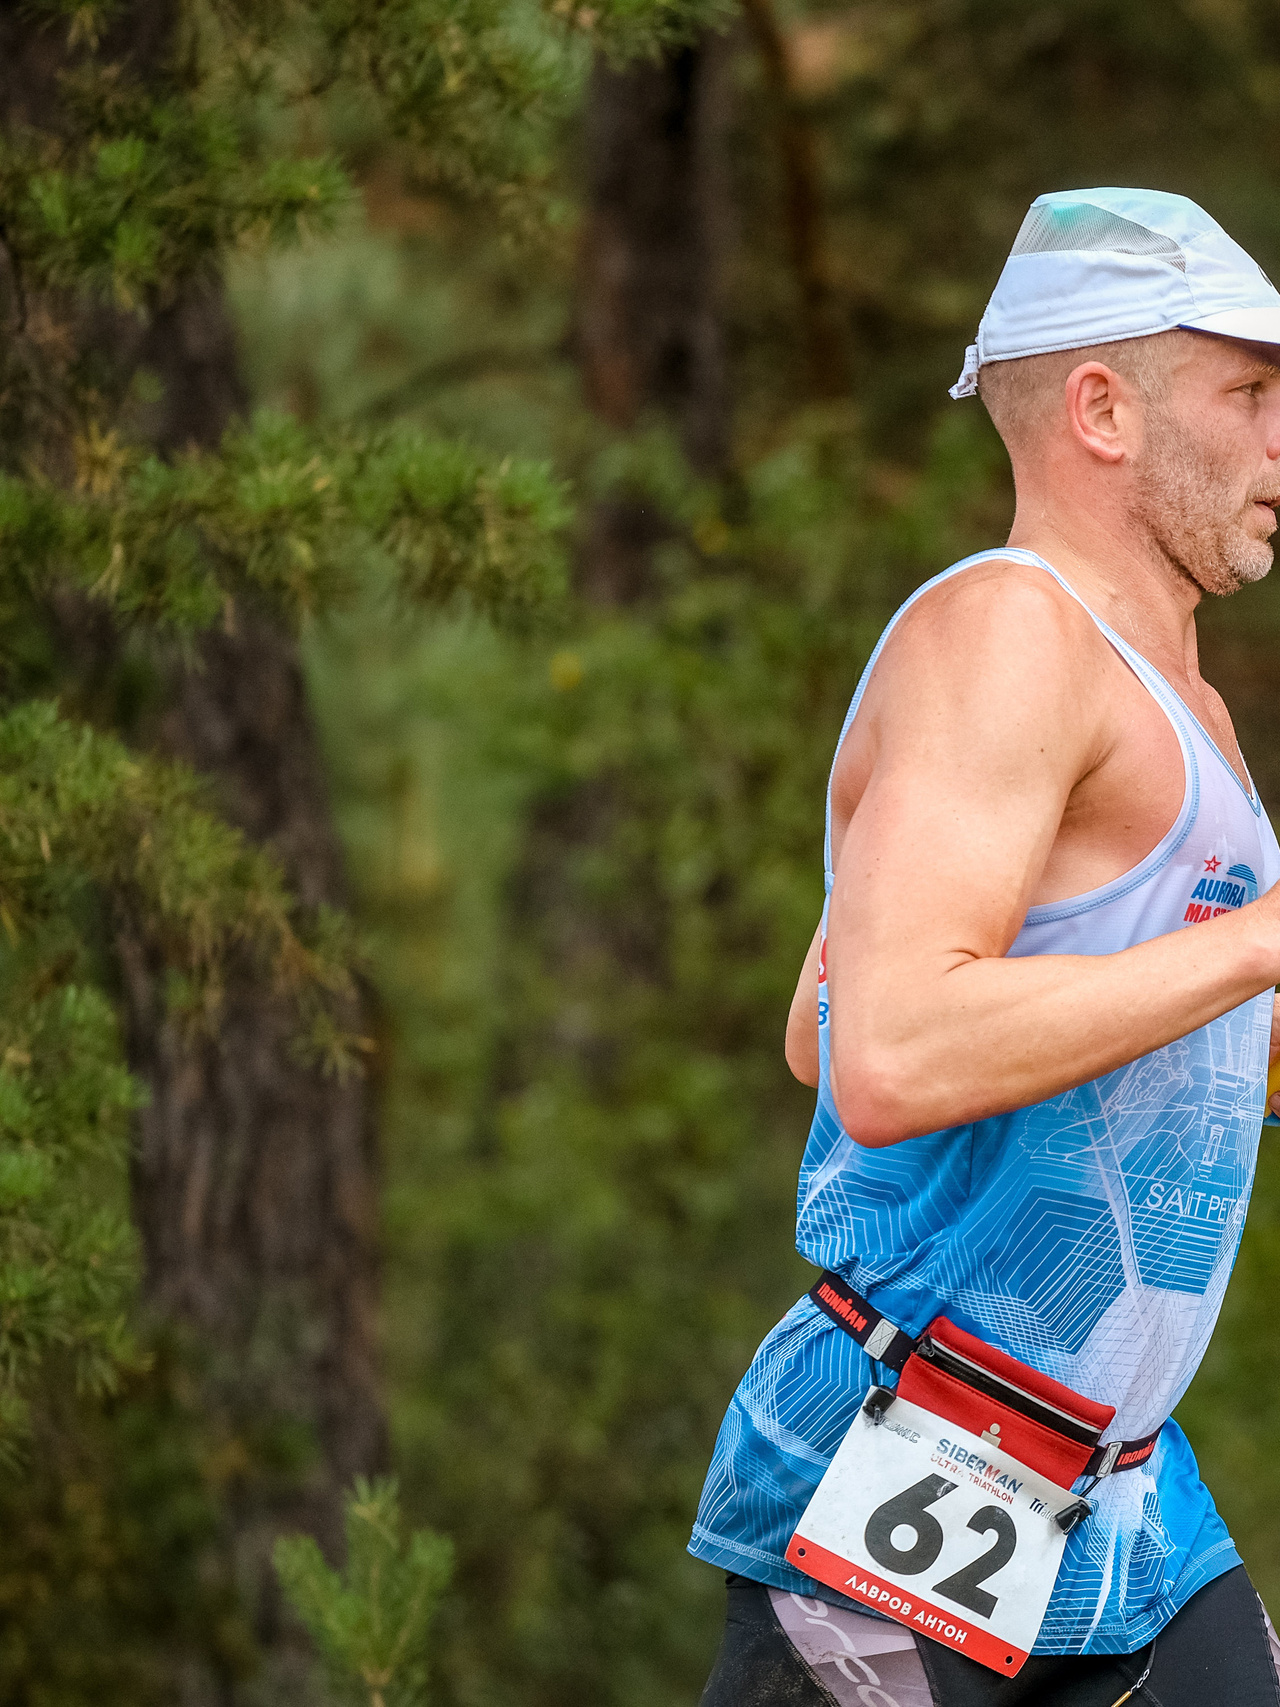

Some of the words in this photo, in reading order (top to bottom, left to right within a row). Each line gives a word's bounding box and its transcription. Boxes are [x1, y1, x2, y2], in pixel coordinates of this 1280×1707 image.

[817, 1282, 868, 1332] IRONMAN
[936, 1438, 1023, 1494] SIBERMAN
[1117, 1441, 1156, 1466] IRONM
[968, 1472, 1014, 1505] TRIATHLON
[864, 1473, 1017, 1620] 62
[845, 1575, 912, 1616] ЛАВРОВ
[913, 1610, 968, 1644] АНТОН
